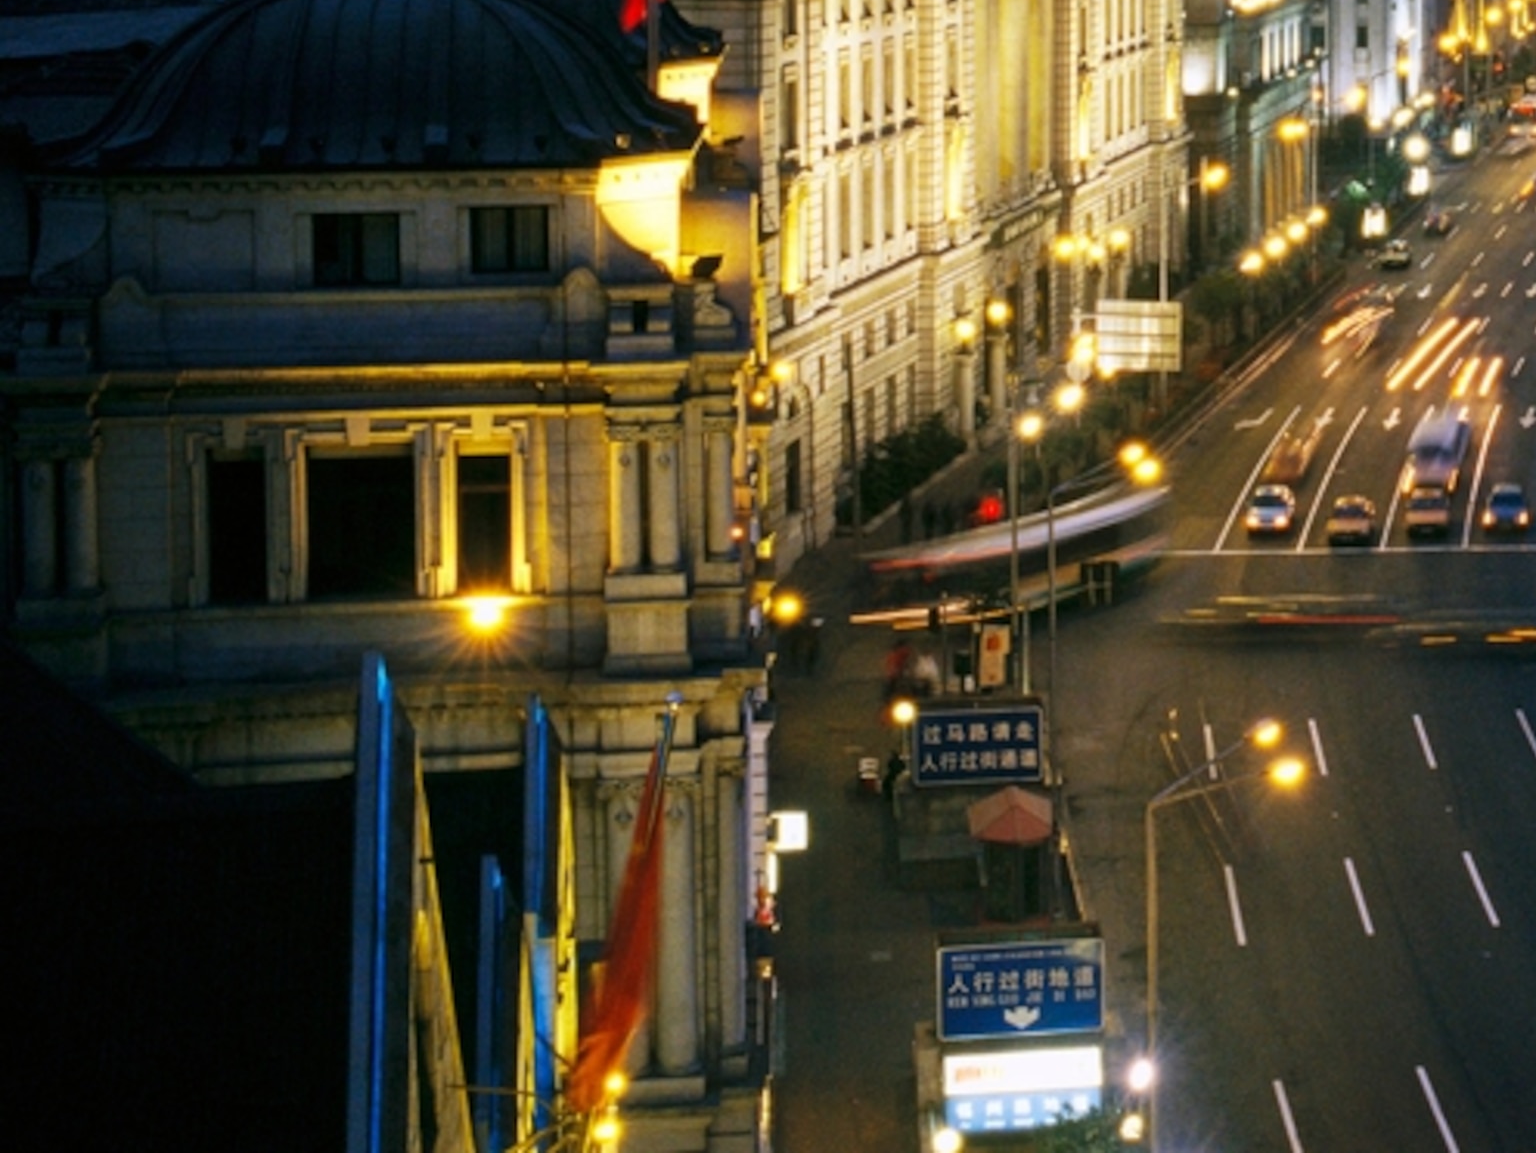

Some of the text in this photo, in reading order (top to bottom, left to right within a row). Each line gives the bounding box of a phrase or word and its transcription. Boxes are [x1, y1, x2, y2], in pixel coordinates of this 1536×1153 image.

[948, 966, 1094, 994] 人行过街地道
